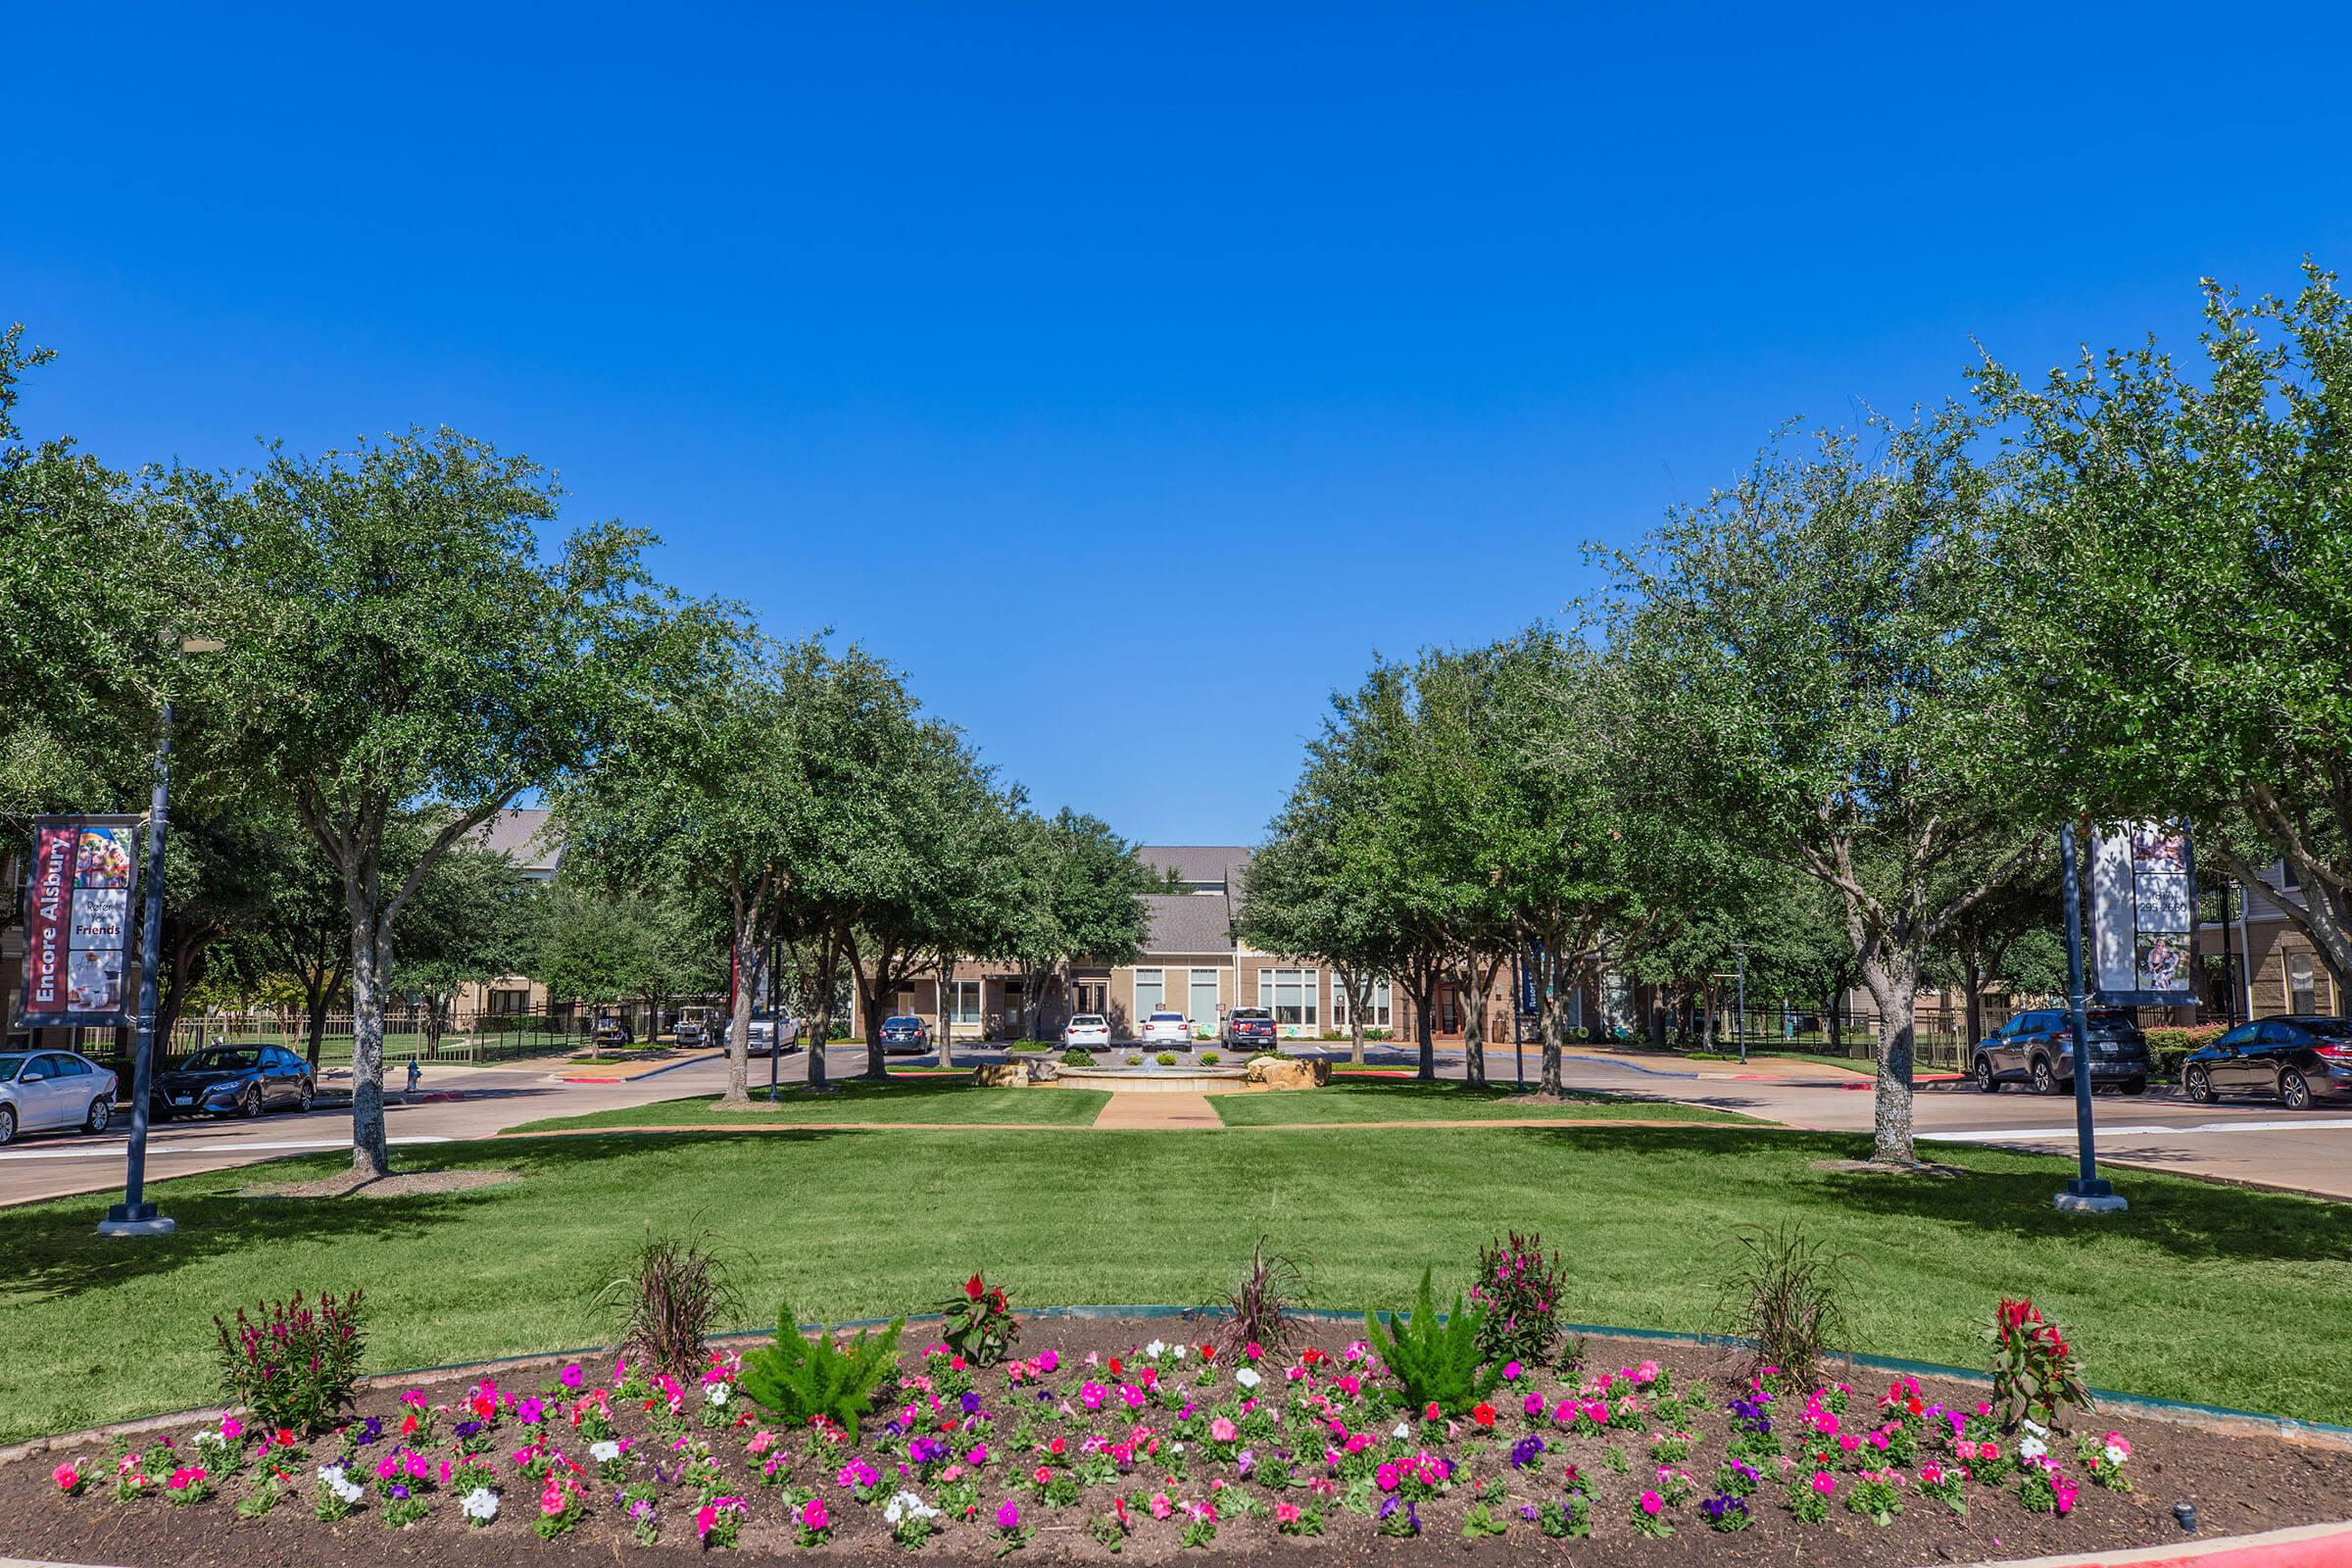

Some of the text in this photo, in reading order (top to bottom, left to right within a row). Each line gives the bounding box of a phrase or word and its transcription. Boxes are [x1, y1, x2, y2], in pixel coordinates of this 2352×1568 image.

[87, 902, 111, 911] Refer
[36, 837, 71, 1002] Encore Alsbury
[75, 925, 121, 935] Friends
